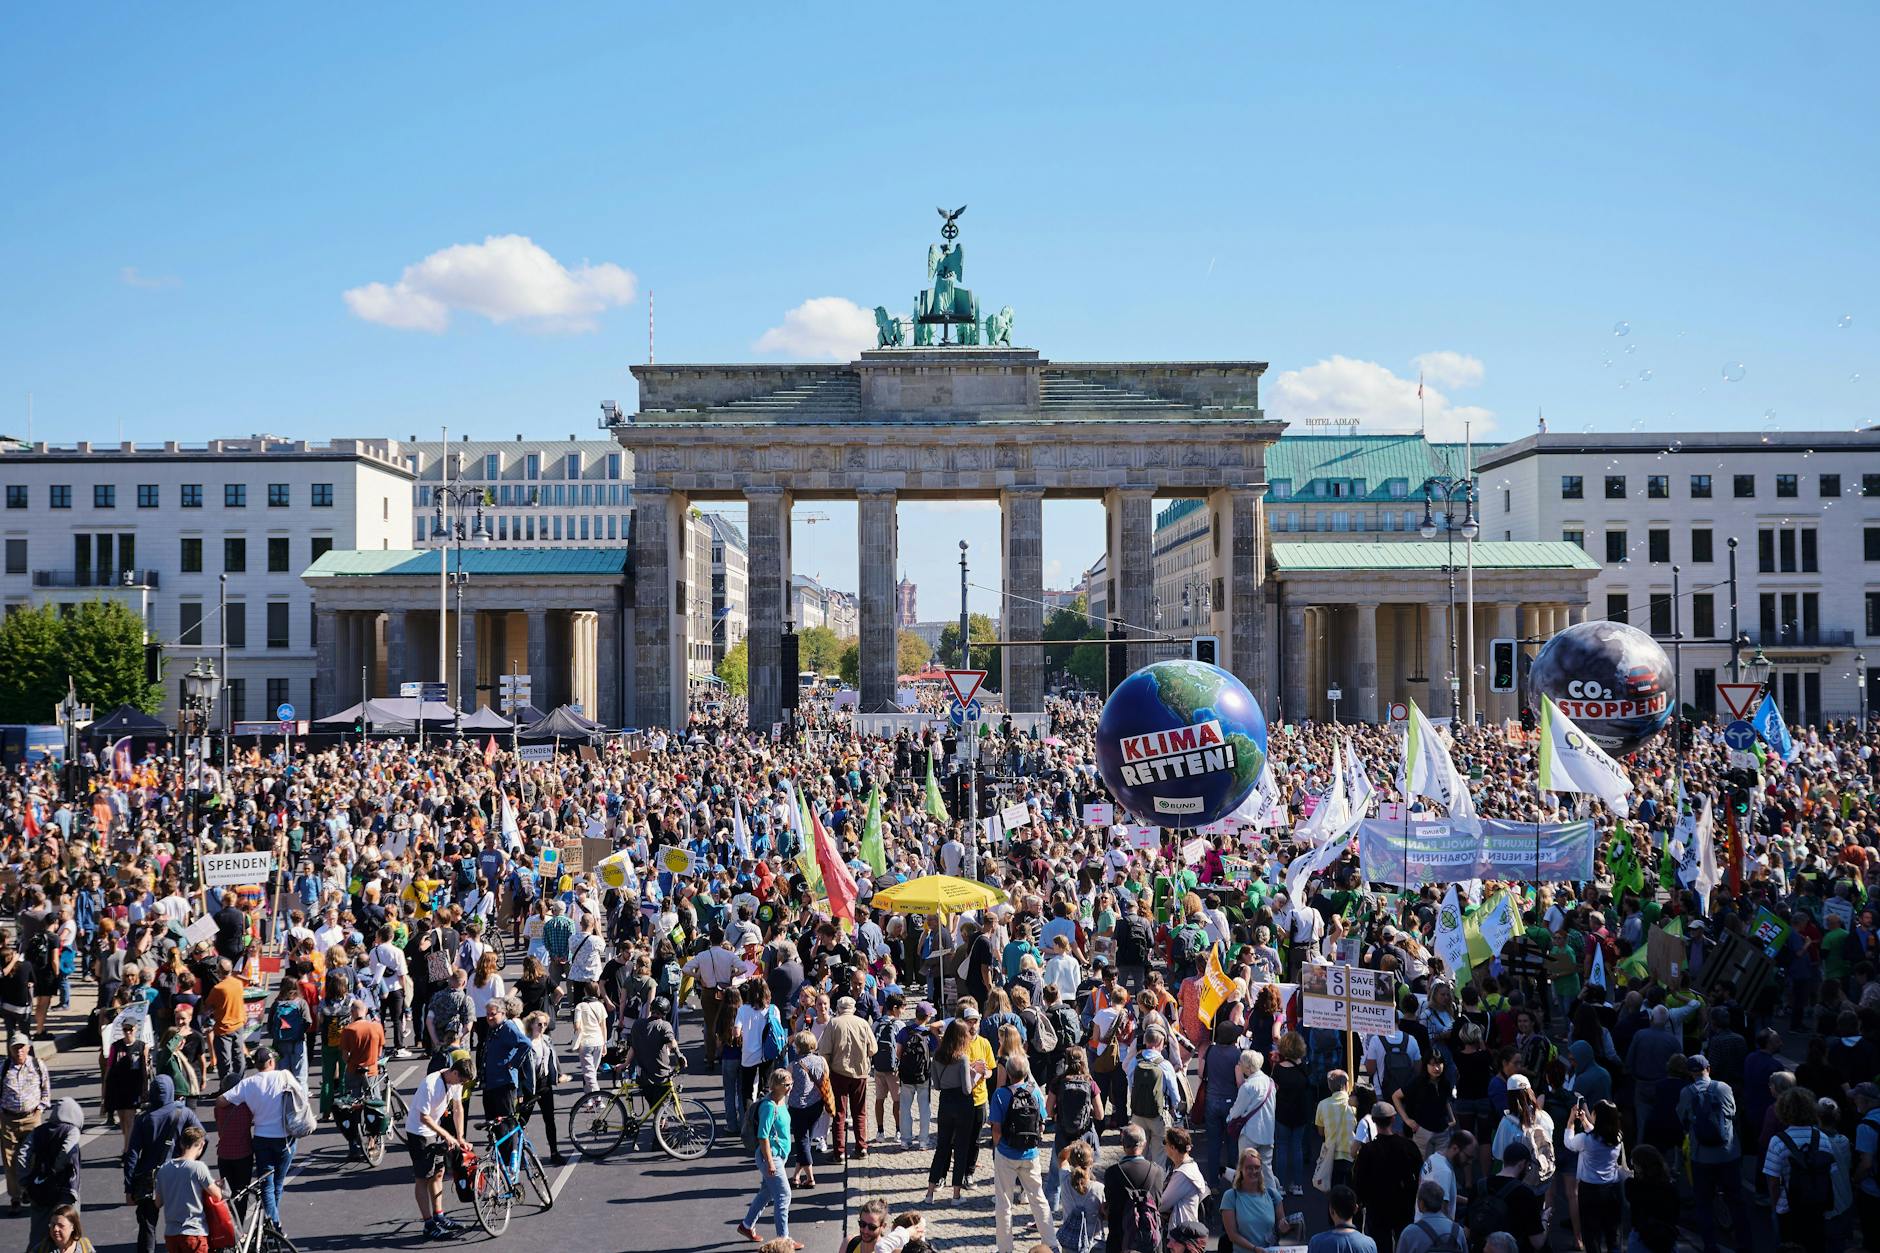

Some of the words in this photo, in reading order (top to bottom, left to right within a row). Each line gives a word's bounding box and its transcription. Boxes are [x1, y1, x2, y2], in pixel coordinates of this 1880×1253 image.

[1305, 418, 1331, 426] HOTEL
[1333, 418, 1360, 426] ADLON
[1559, 694, 1665, 718] STOPPEN!
[1123, 723, 1221, 761] KLIMA
[521, 747, 552, 755] SPENDEN
[1120, 745, 1235, 787] RETTEN!
[208, 857, 267, 871] SPENDEN
[1351, 976, 1374, 986] SAVE
[1351, 988, 1371, 997] OUR
[1351, 1005, 1386, 1016] PLANET
